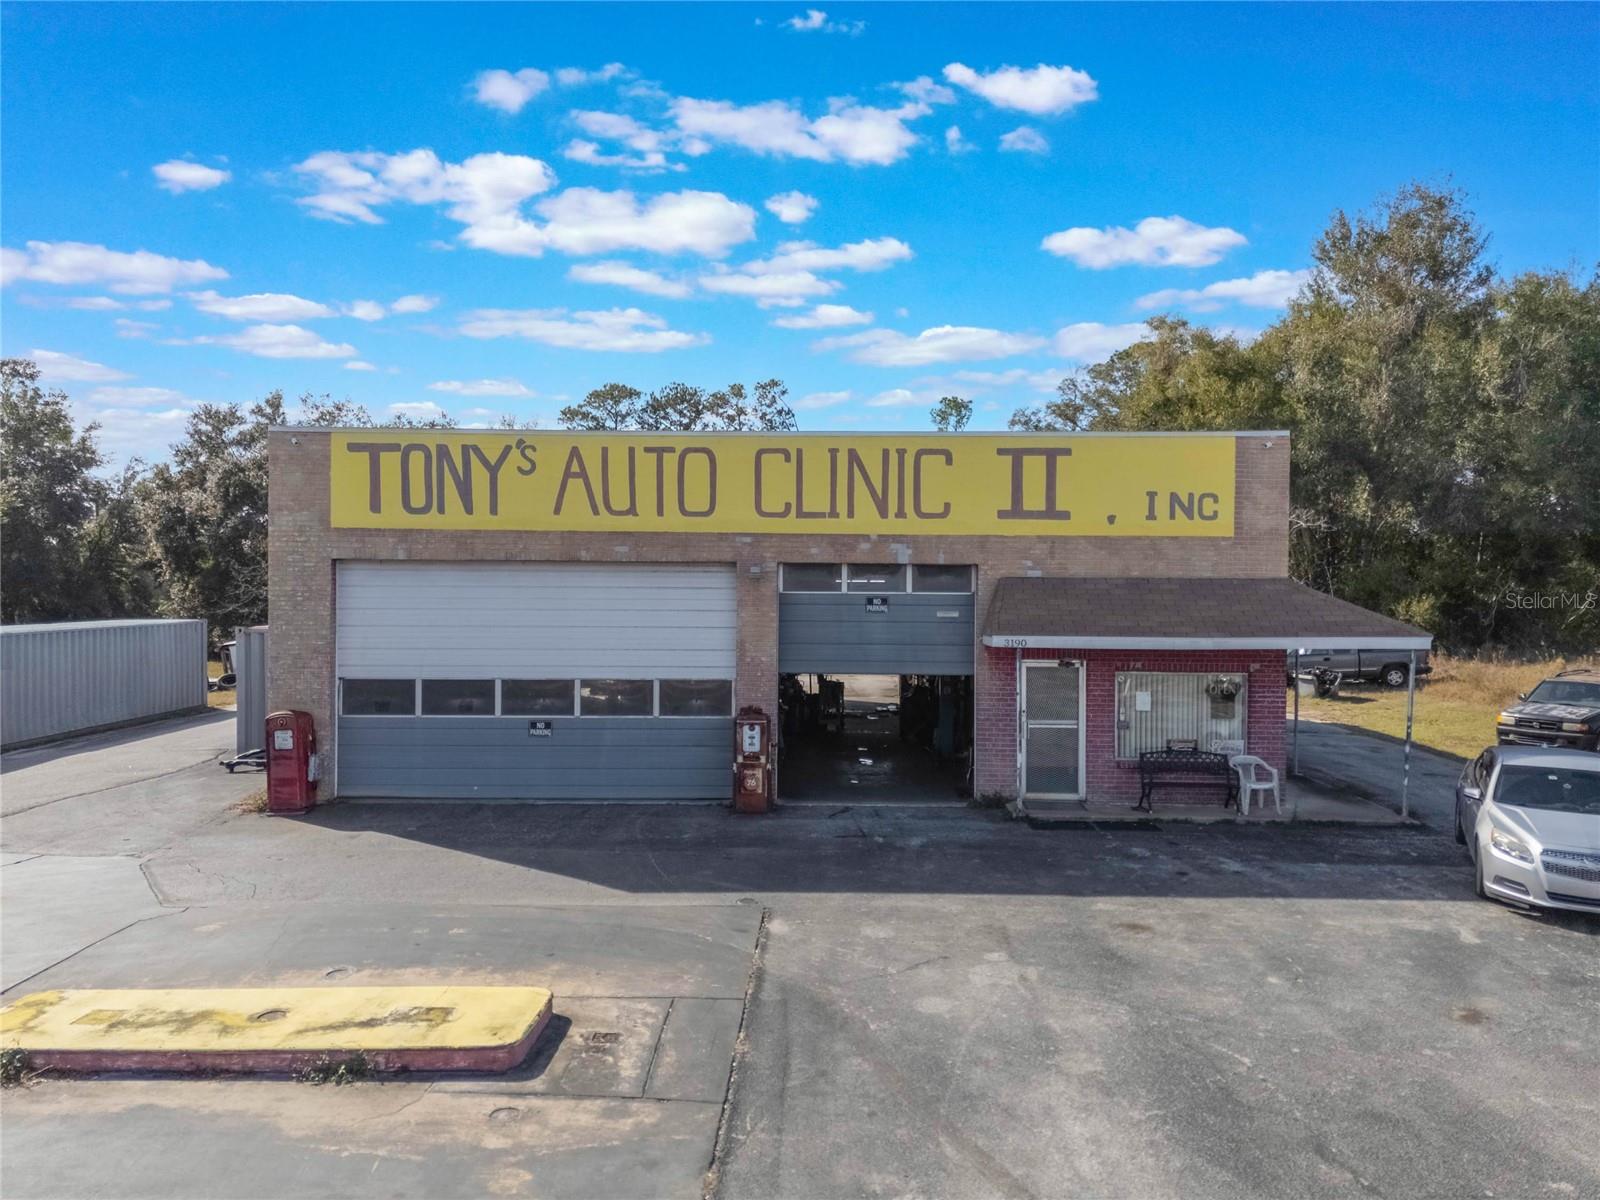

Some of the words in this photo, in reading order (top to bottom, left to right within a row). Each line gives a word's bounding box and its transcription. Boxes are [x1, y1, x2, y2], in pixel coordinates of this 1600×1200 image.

[553, 446, 718, 518] AUTO
[754, 447, 954, 520] CLINIC
[996, 447, 1073, 521] II
[1145, 490, 1220, 521] INC
[866, 605, 888, 613] PARKING
[1003, 639, 1028, 647] 3190
